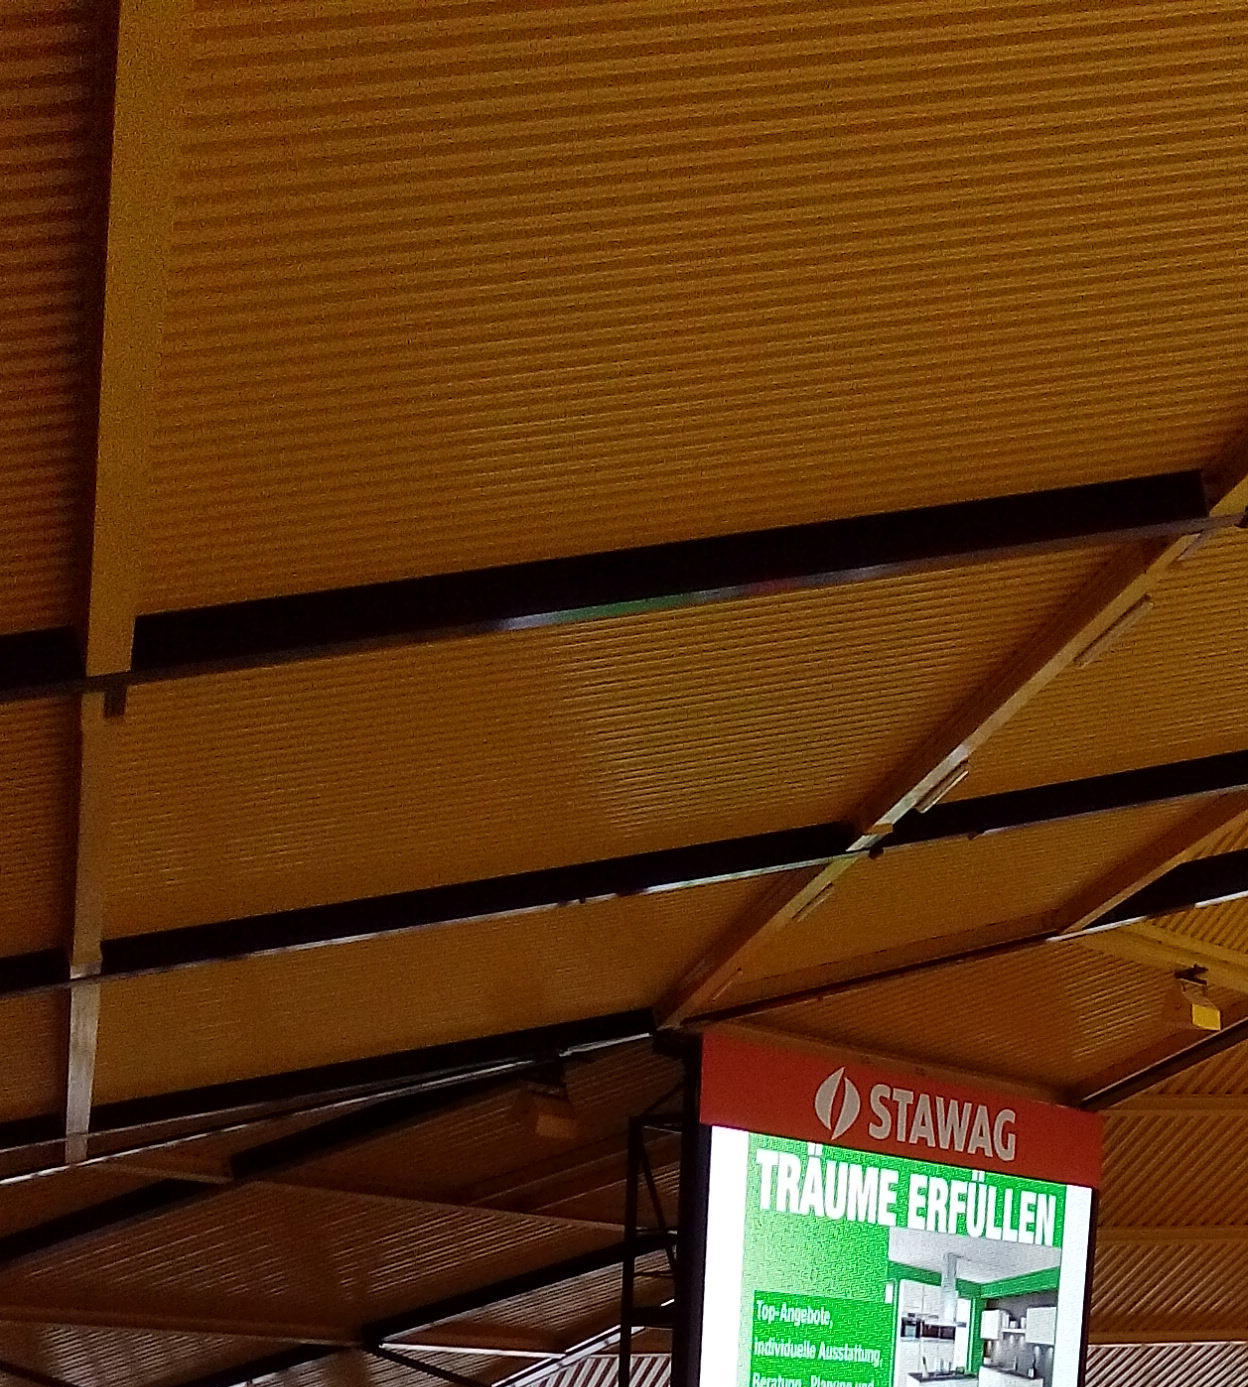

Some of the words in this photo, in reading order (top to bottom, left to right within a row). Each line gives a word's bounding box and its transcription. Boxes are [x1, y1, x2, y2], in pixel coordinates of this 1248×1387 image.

[868, 1084, 1016, 1162] STAWAG
[756, 1143, 900, 1227] TRÄUME
[907, 1169, 1057, 1247] ERFÜLLEN
[756, 1300, 834, 1329] Top-Angebote,
[818, 1341, 883, 1368] Ausstattung,
